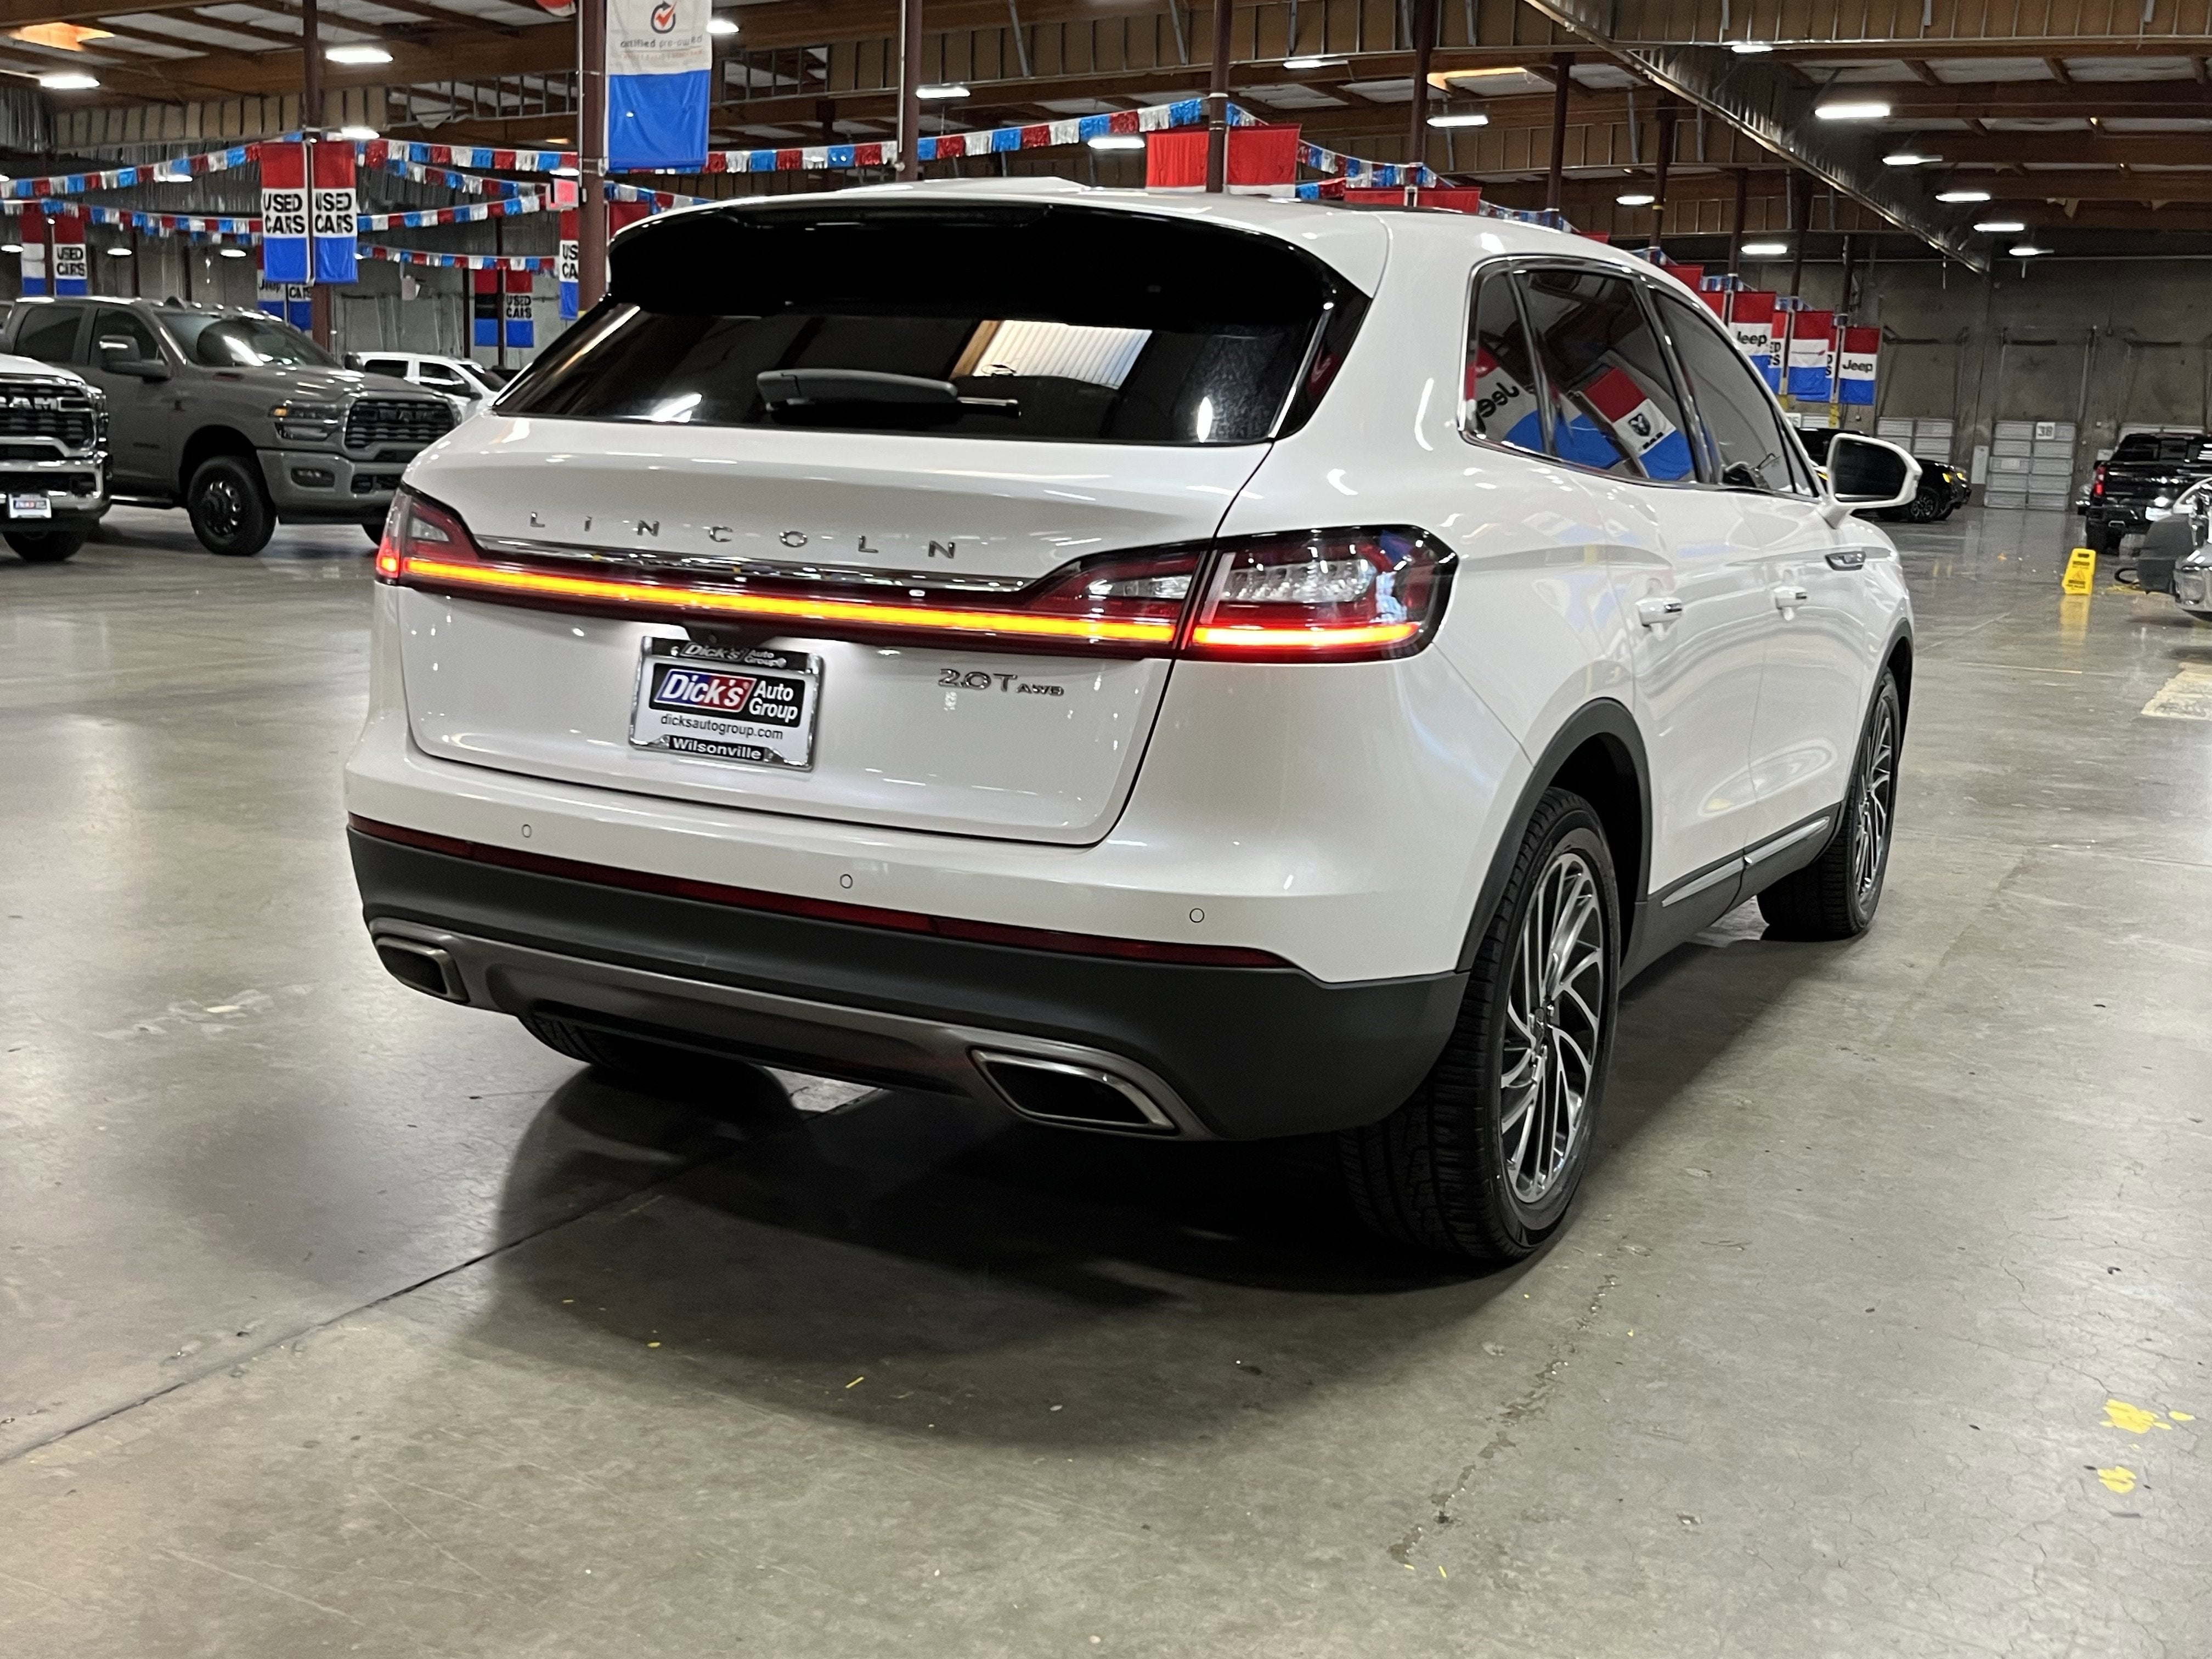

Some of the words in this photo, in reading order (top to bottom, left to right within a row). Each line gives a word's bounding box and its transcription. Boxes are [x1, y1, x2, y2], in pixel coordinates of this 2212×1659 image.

[659, 35, 703, 50] pre-owed
[264, 193, 303, 212] USED
[315, 193, 352, 212] USED
[265, 215, 305, 234] CARS
[315, 214, 353, 233] CARS
[57, 247, 83, 260] USED
[562, 245, 578, 260] US
[57, 263, 85, 276] CARS
[562, 263, 578, 279] CA
[506, 295, 531, 306] USED
[1842, 359, 1874, 374] Jeep
[0, 396, 57, 410] AM
[530, 511, 956, 560] LINCOLN
[685, 644, 744, 661] Dick's
[749, 650, 775, 659] Auto
[662, 674, 744, 707] Dick's
[754, 680, 794, 701] Auto
[748, 697, 798, 723] Group
[661, 713, 783, 740] dicksautogroup.com
[673, 737, 762, 760] Wilsonville
